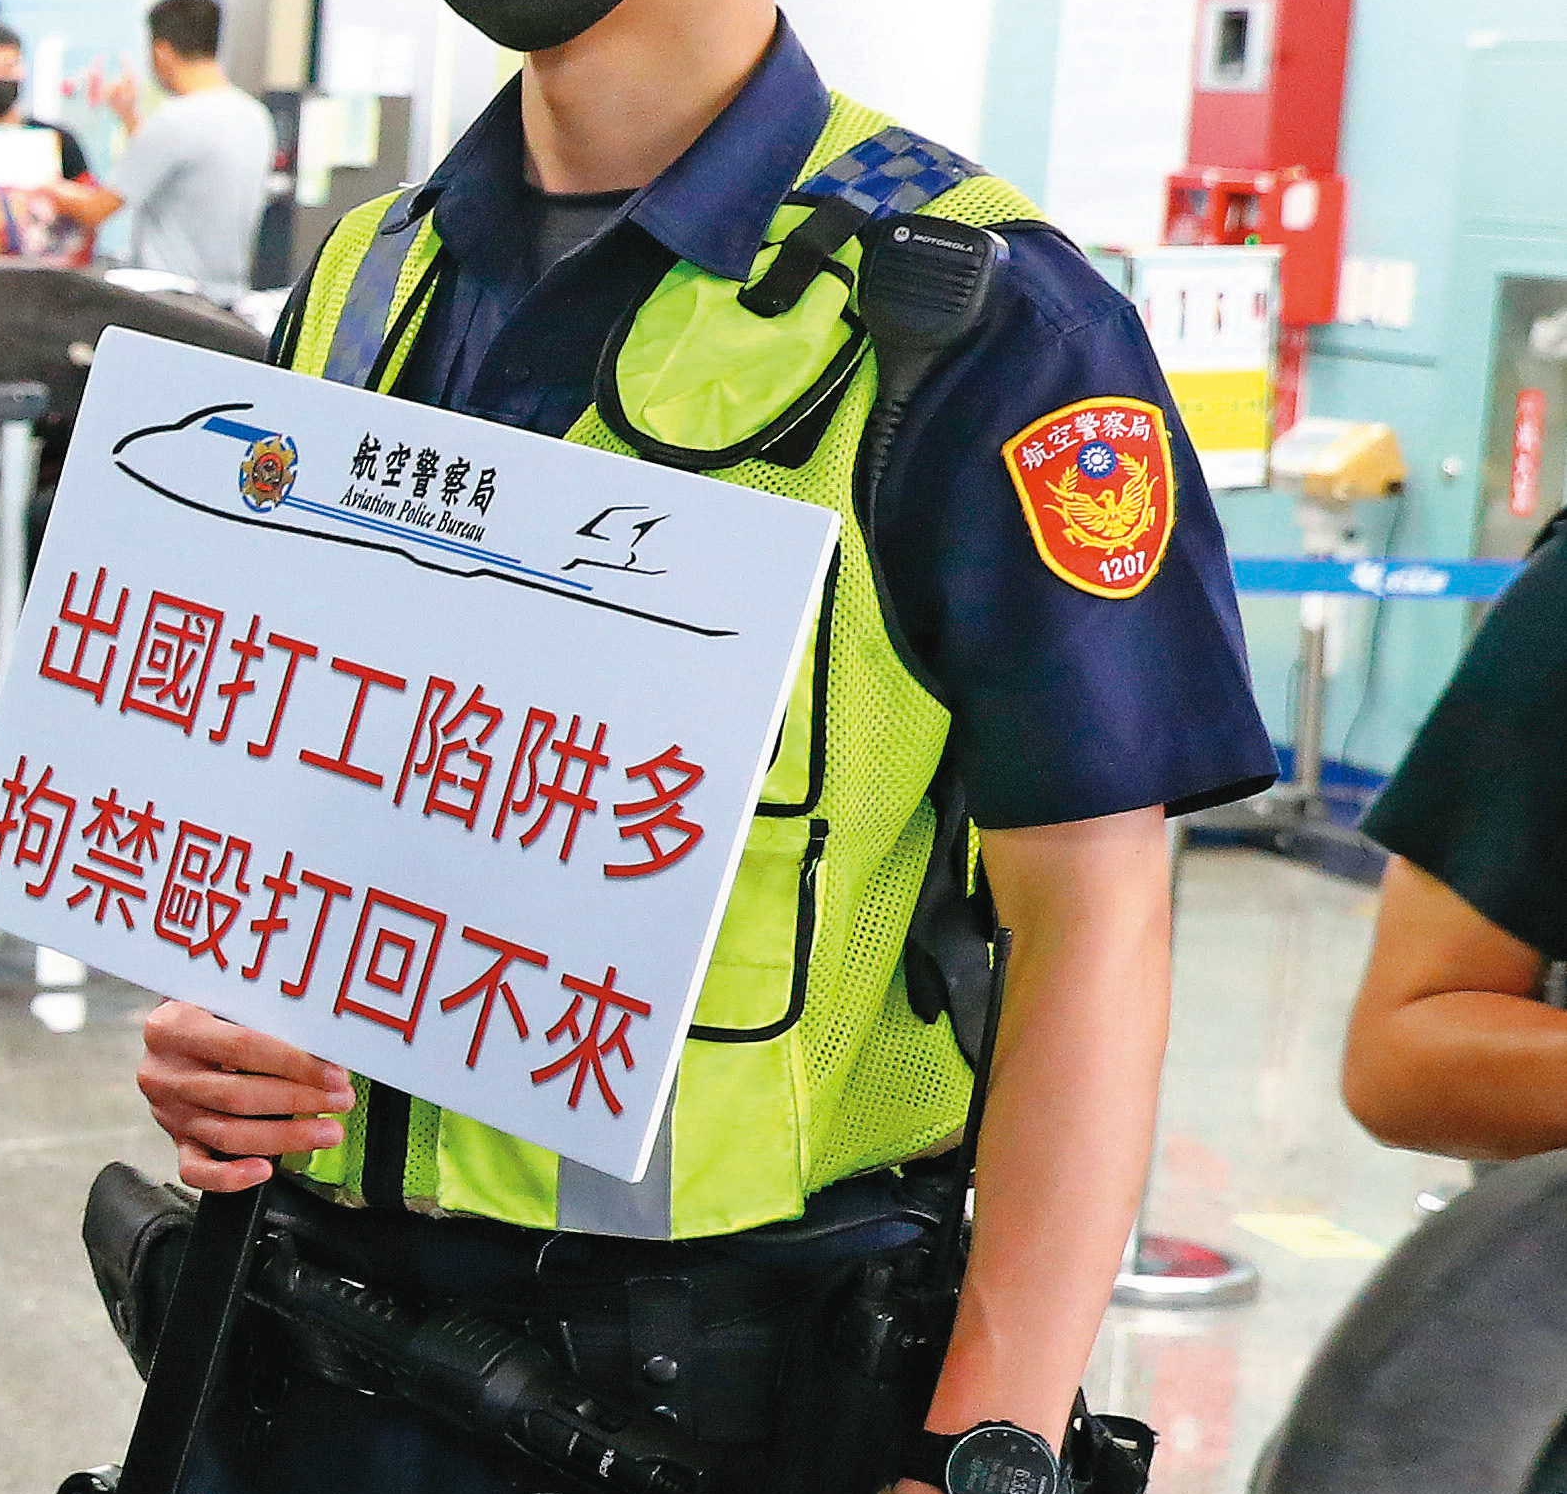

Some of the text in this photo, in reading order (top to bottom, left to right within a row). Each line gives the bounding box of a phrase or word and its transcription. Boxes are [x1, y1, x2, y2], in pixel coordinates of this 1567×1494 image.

[912, 233, 975, 253] MOTOROLA
[1020, 410, 1152, 472] 航空警察局
[350, 431, 497, 517] 航空警察局
[339, 484, 486, 542] Aviation Police Bureau
[1099, 550, 1147, 583] 1207
[39, 565, 707, 881] 出國打工陷阱多
